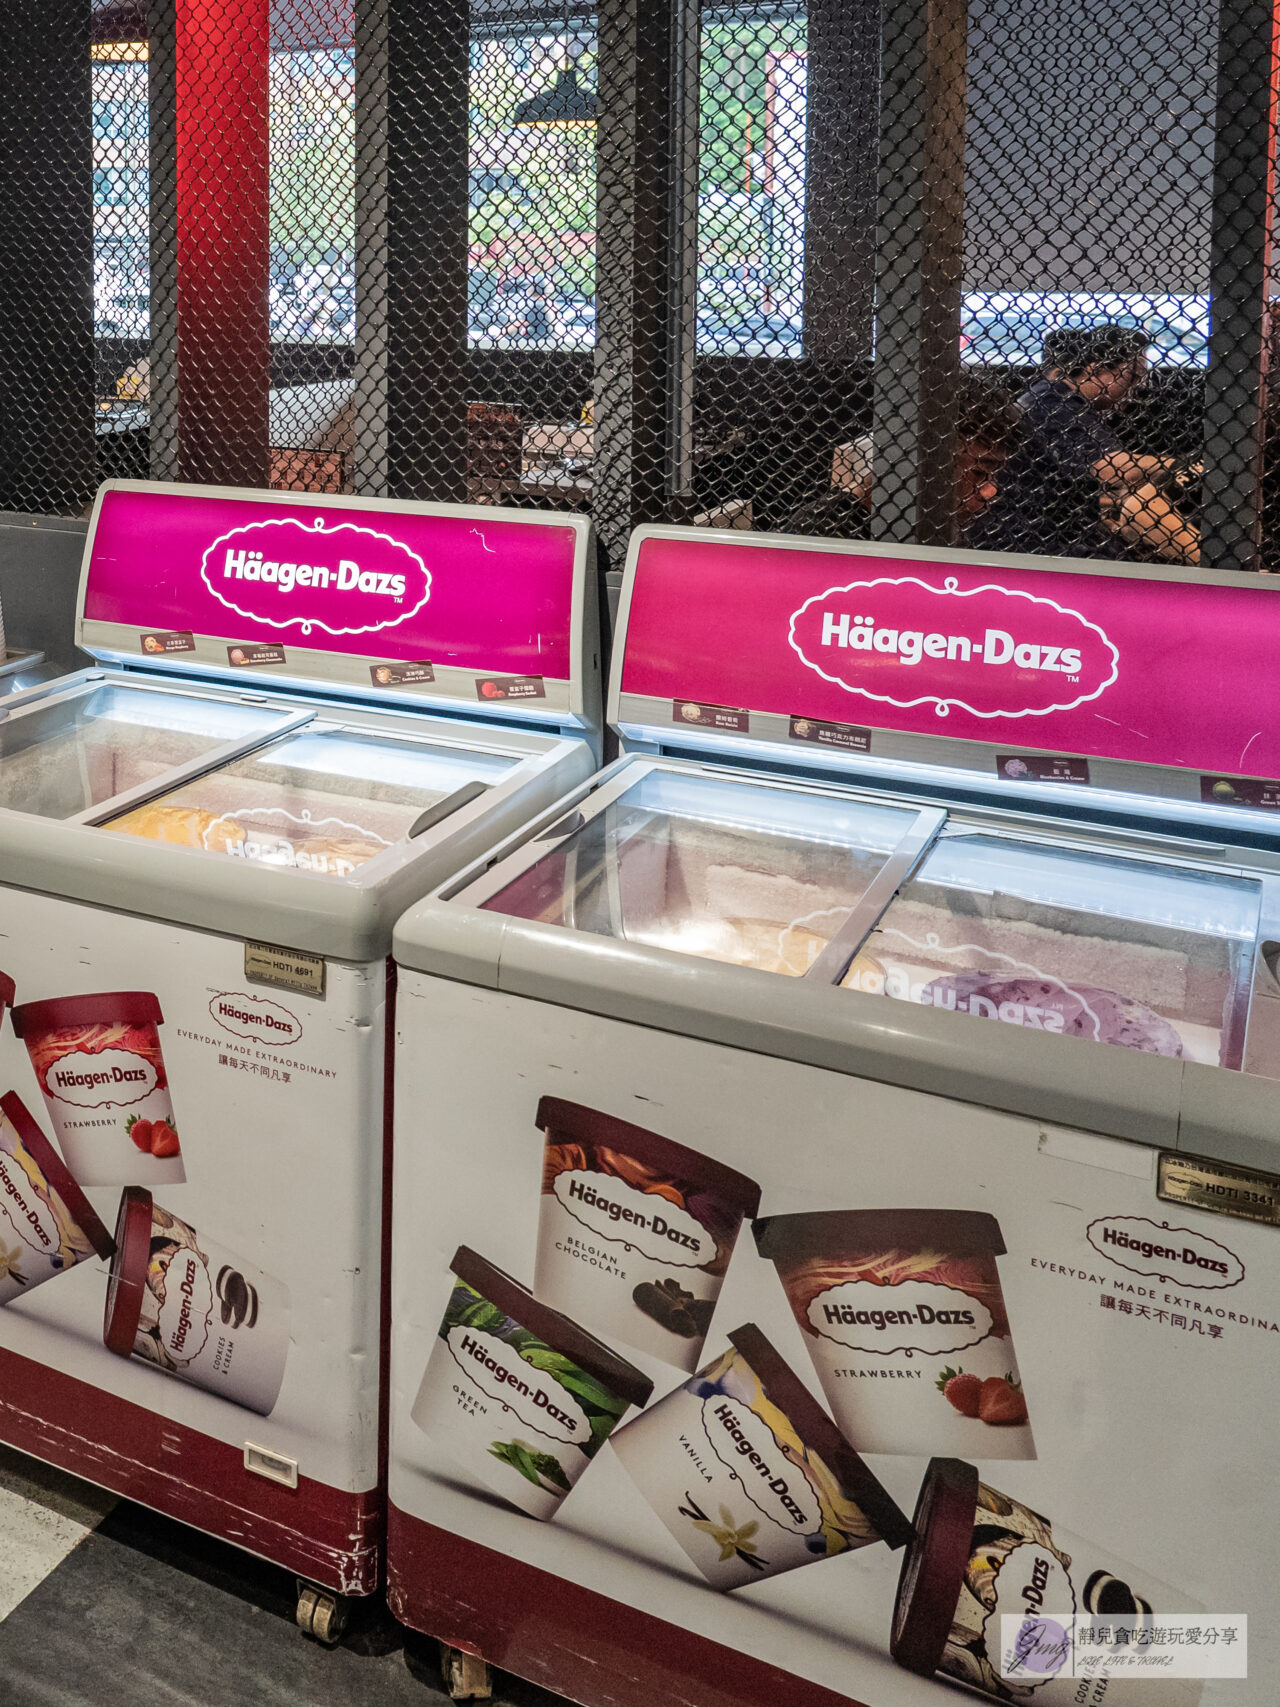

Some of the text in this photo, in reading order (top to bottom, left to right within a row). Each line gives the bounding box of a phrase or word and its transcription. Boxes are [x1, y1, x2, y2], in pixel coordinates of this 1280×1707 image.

[224, 548, 406, 597] Häagen-Dazs
[820, 612, 1083, 674] Häagen-Dazs
[273, 961, 293, 972] HDTI
[218, 1002, 293, 1033] Häagen-Dazs
[177, 1028, 337, 1079] EVERYDAY MADE EXTRAORDINARY
[218, 1053, 292, 1084] 讓每天不同凡享
[55, 1066, 147, 1090] Häagen-Dazs
[63, 1118, 117, 1129] STRAWBERRY
[1205, 1182, 1273, 1206] HDTI 3341
[569, 1179, 701, 1252] Häagen-Dazs
[555, 1242, 627, 1280] CHOCOLATE
[567, 1236, 618, 1265] BELGIAN
[1103, 1227, 1229, 1275] Häagen-Dazs
[170, 1258, 197, 1353] Häagen-Dazs
[1031, 1257, 1280, 1333] EVERYDAY MADE EXTRAORDINA
[822, 1304, 976, 1331] Häagen-Dazs
[1100, 1294, 1225, 1339] 讓每天不同凡享
[213, 1336, 226, 1370] COOKIES
[224, 1341, 235, 1369] CREAM
[460, 1334, 577, 1432] Häagen-Dazs
[834, 1368, 923, 1379] STRAWBERRY
[452, 1384, 488, 1415] GREEN
[457, 1398, 476, 1417] TEA
[678, 1434, 713, 1484] VANILLA
[713, 1403, 808, 1526] Häagen-Dazs
